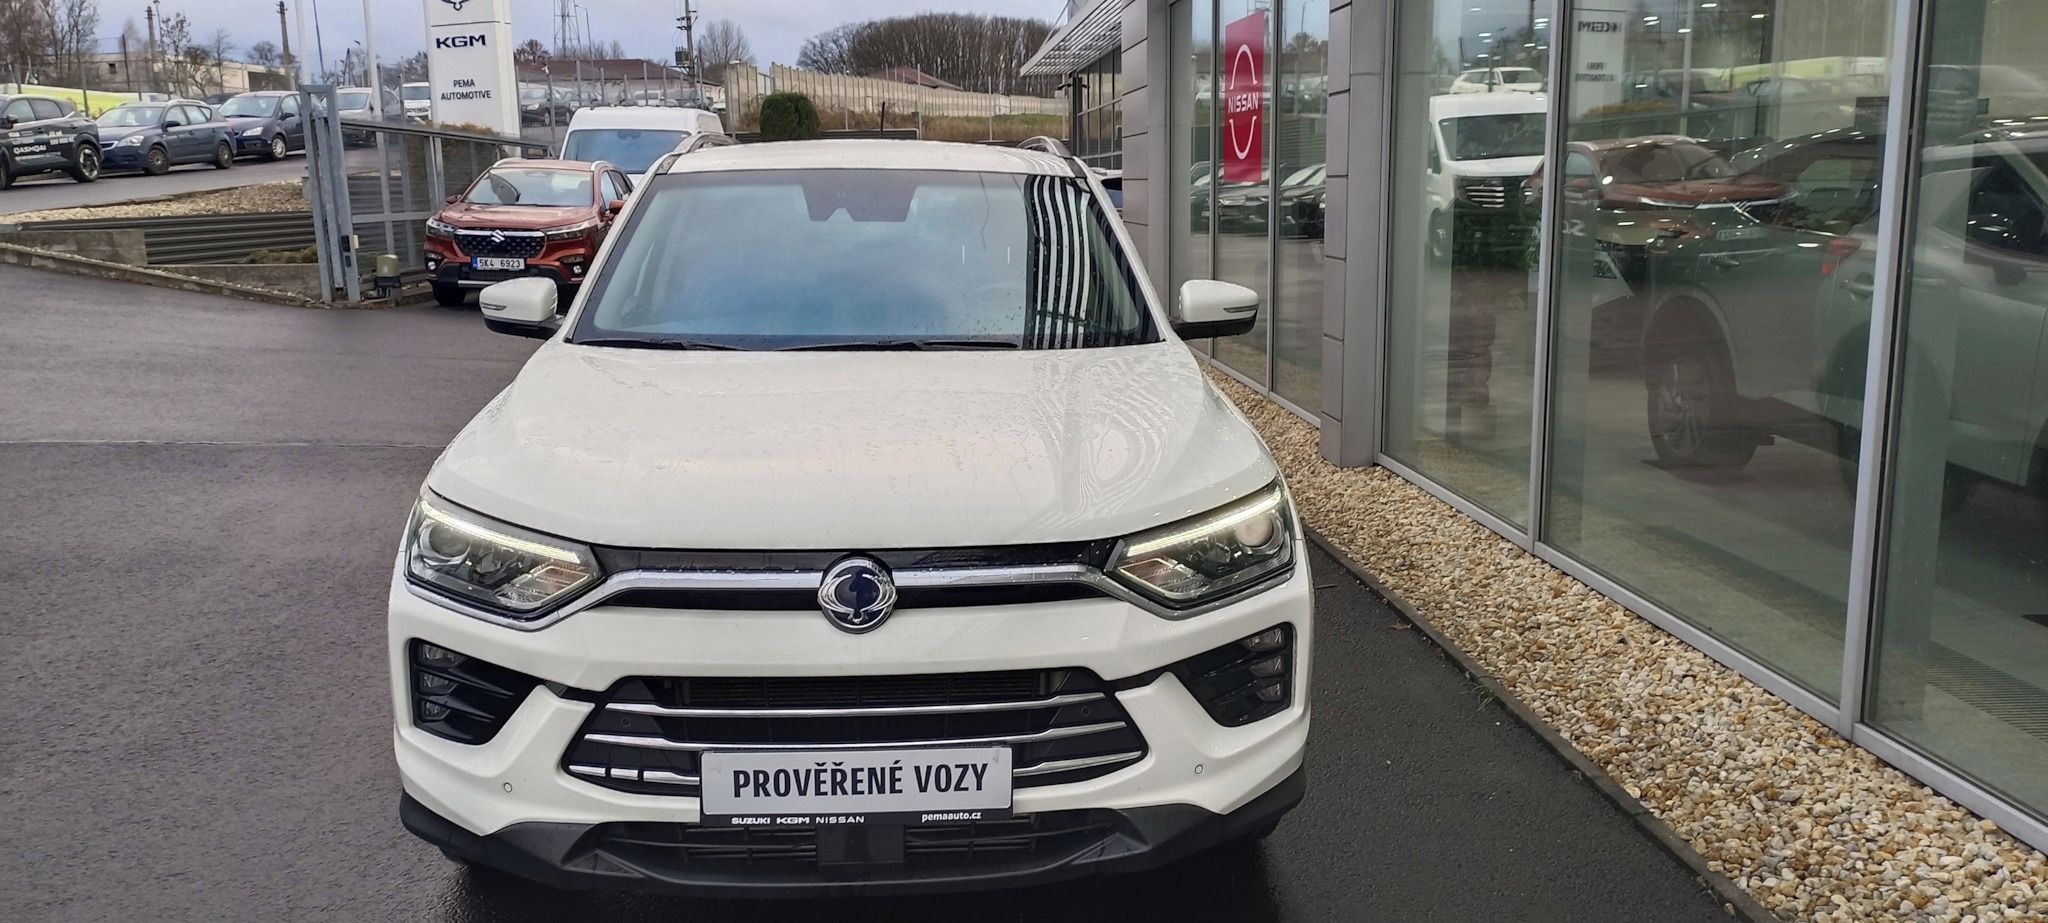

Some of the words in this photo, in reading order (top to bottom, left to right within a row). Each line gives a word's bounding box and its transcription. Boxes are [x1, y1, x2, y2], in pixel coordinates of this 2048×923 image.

[436, 34, 486, 48] KGM
[453, 79, 476, 88] PEMA
[441, 90, 491, 100] AUTOMOTIVE
[1228, 91, 1259, 114] NISSAN
[14, 145, 46, 154] QASHQAI
[479, 259, 495, 267] 5K4
[500, 259, 520, 268] 6923
[733, 759, 903, 798] PROVĚŘENÉ
[914, 763, 988, 793] VOZY
[731, 817, 771, 825] SUZUKI
[776, 816, 810, 825] KGM
[815, 815, 865, 824] NISSAN
[921, 811, 982, 823] pemaauto.cz
